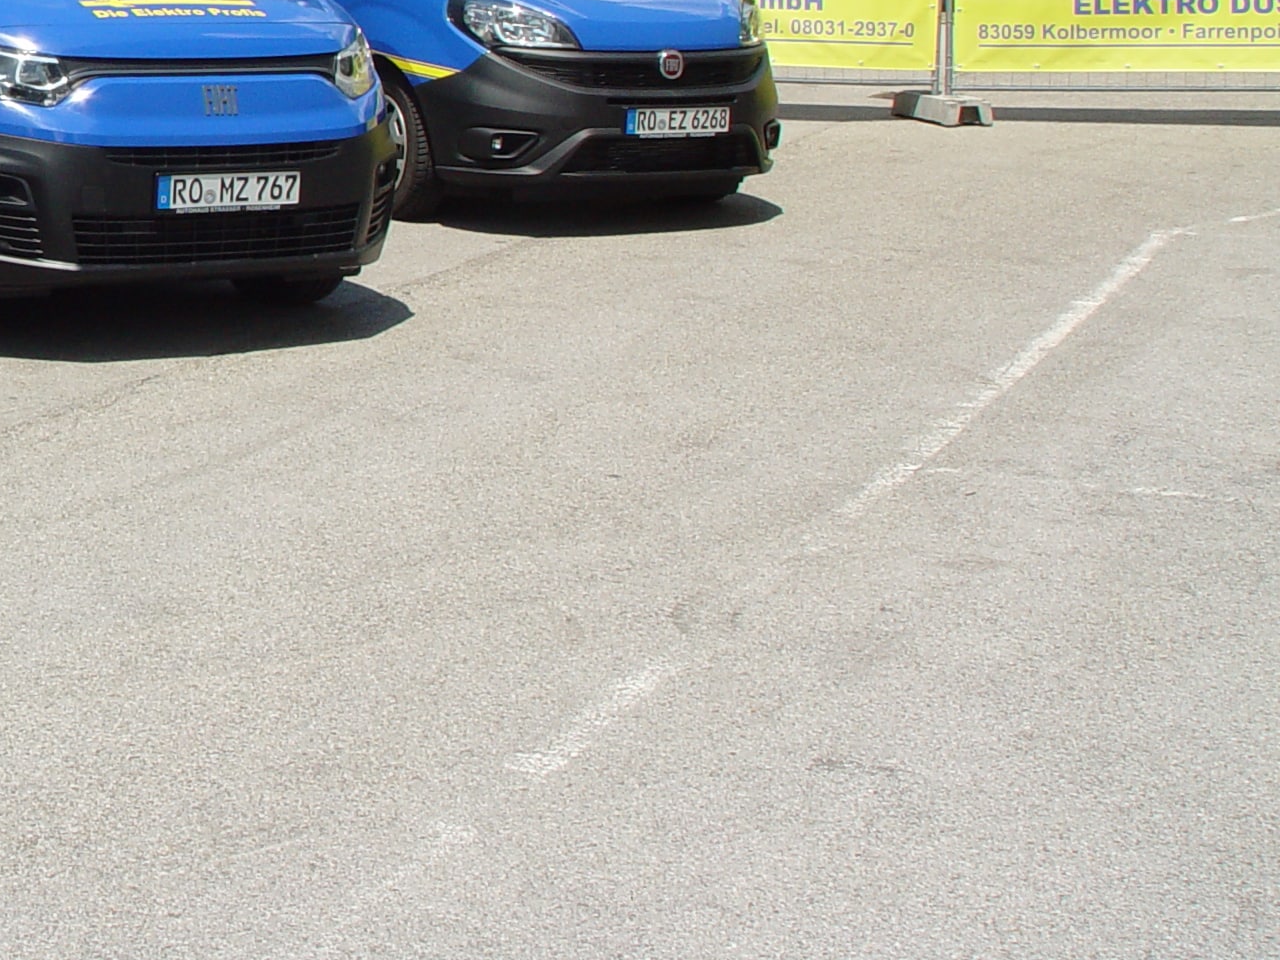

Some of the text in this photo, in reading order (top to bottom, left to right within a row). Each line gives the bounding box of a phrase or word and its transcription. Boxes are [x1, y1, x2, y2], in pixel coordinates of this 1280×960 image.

[92, 9, 129, 19] Die
[131, 8, 205, 17] Elektro
[764, 19, 914, 38] el. 08031-2937-0
[978, 24, 1035, 40] 83059
[1042, 23, 1161, 40] Kolbermoor
[637, 109, 727, 131] RO EZ 6268
[173, 178, 203, 205] RO
[220, 176, 249, 202] MZ
[256, 175, 297, 201] 767
